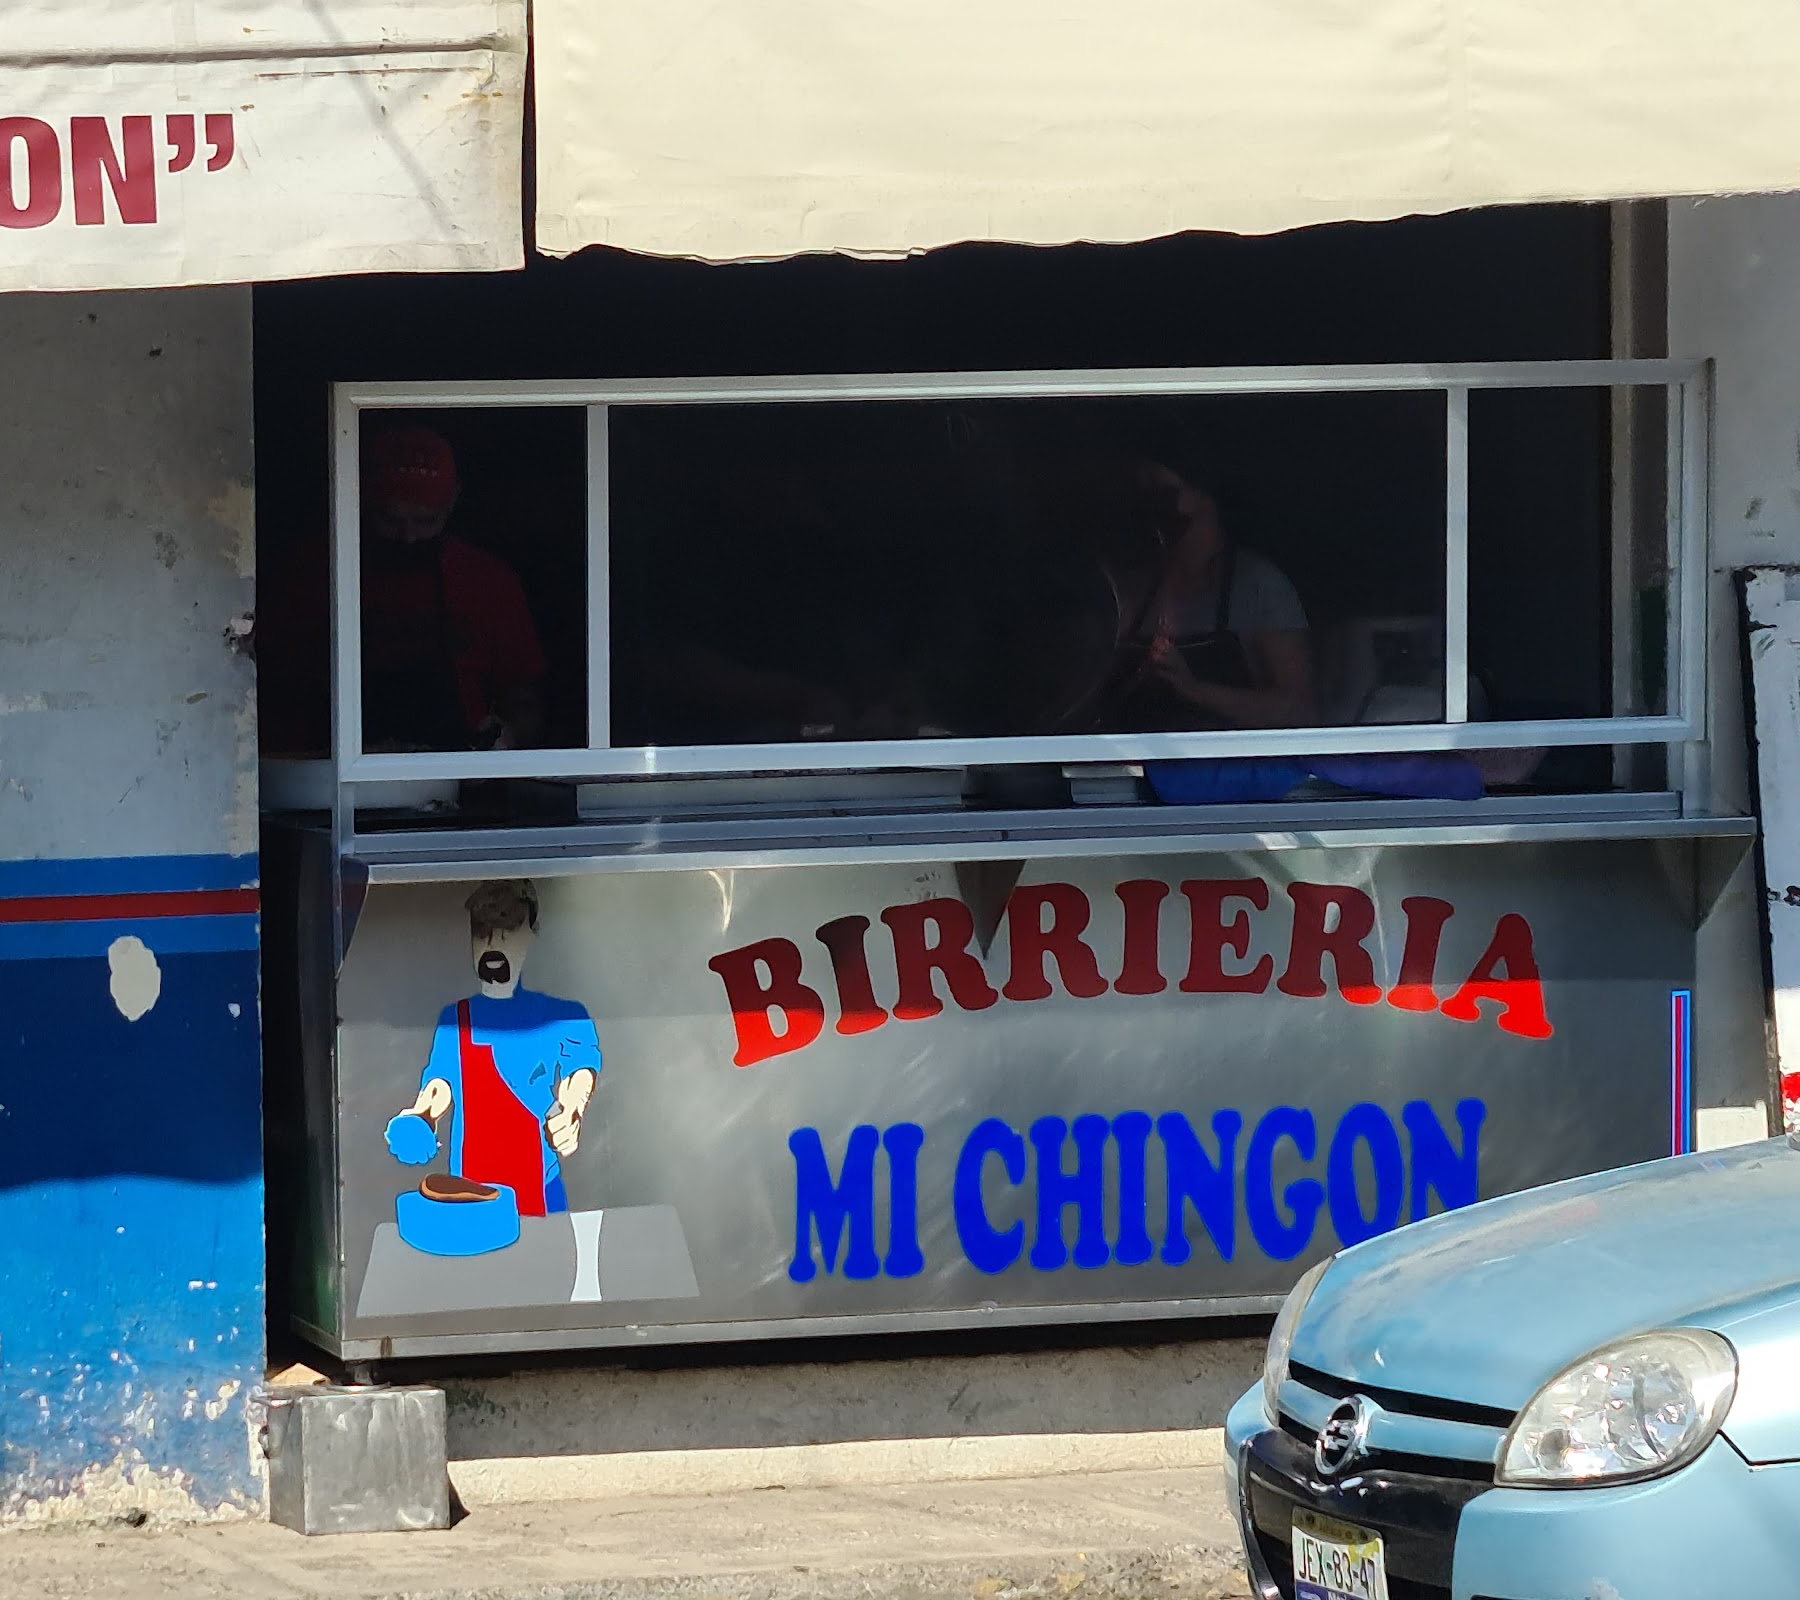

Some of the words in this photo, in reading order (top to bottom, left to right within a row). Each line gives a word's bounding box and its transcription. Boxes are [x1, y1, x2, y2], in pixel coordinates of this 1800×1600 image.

[707, 877, 1555, 1069] BIRRIERIA
[787, 1122, 926, 1284] MI
[952, 1097, 1488, 1276] CHINGON
[1298, 1537, 1378, 1600] JEX-83-47
